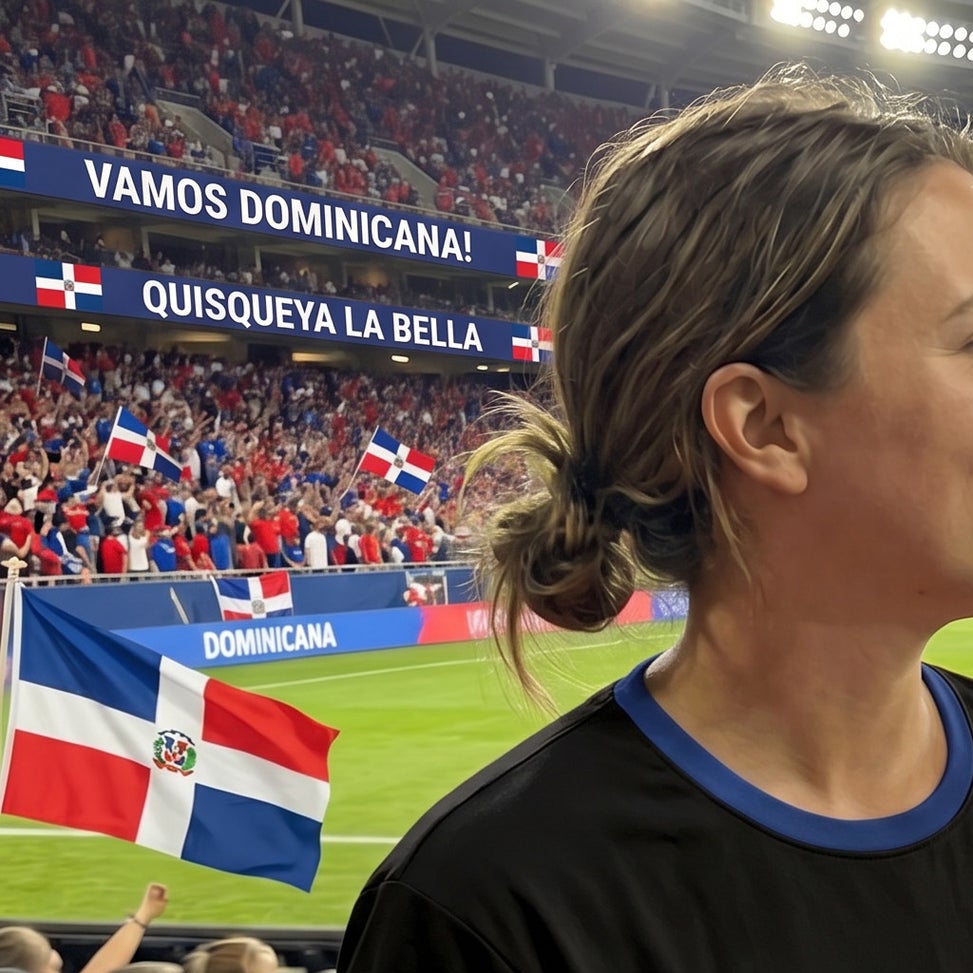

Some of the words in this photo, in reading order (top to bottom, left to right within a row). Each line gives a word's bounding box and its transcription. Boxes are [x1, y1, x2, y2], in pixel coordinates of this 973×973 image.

[83, 159, 228, 220] VAMOS
[239, 188, 472, 263] DOMINICANA!
[142, 279, 337, 335] QUISQUEYA
[344, 305, 385, 341] LA
[392, 312, 484, 352] BELLA
[202, 621, 338, 660] DOMINICANA
